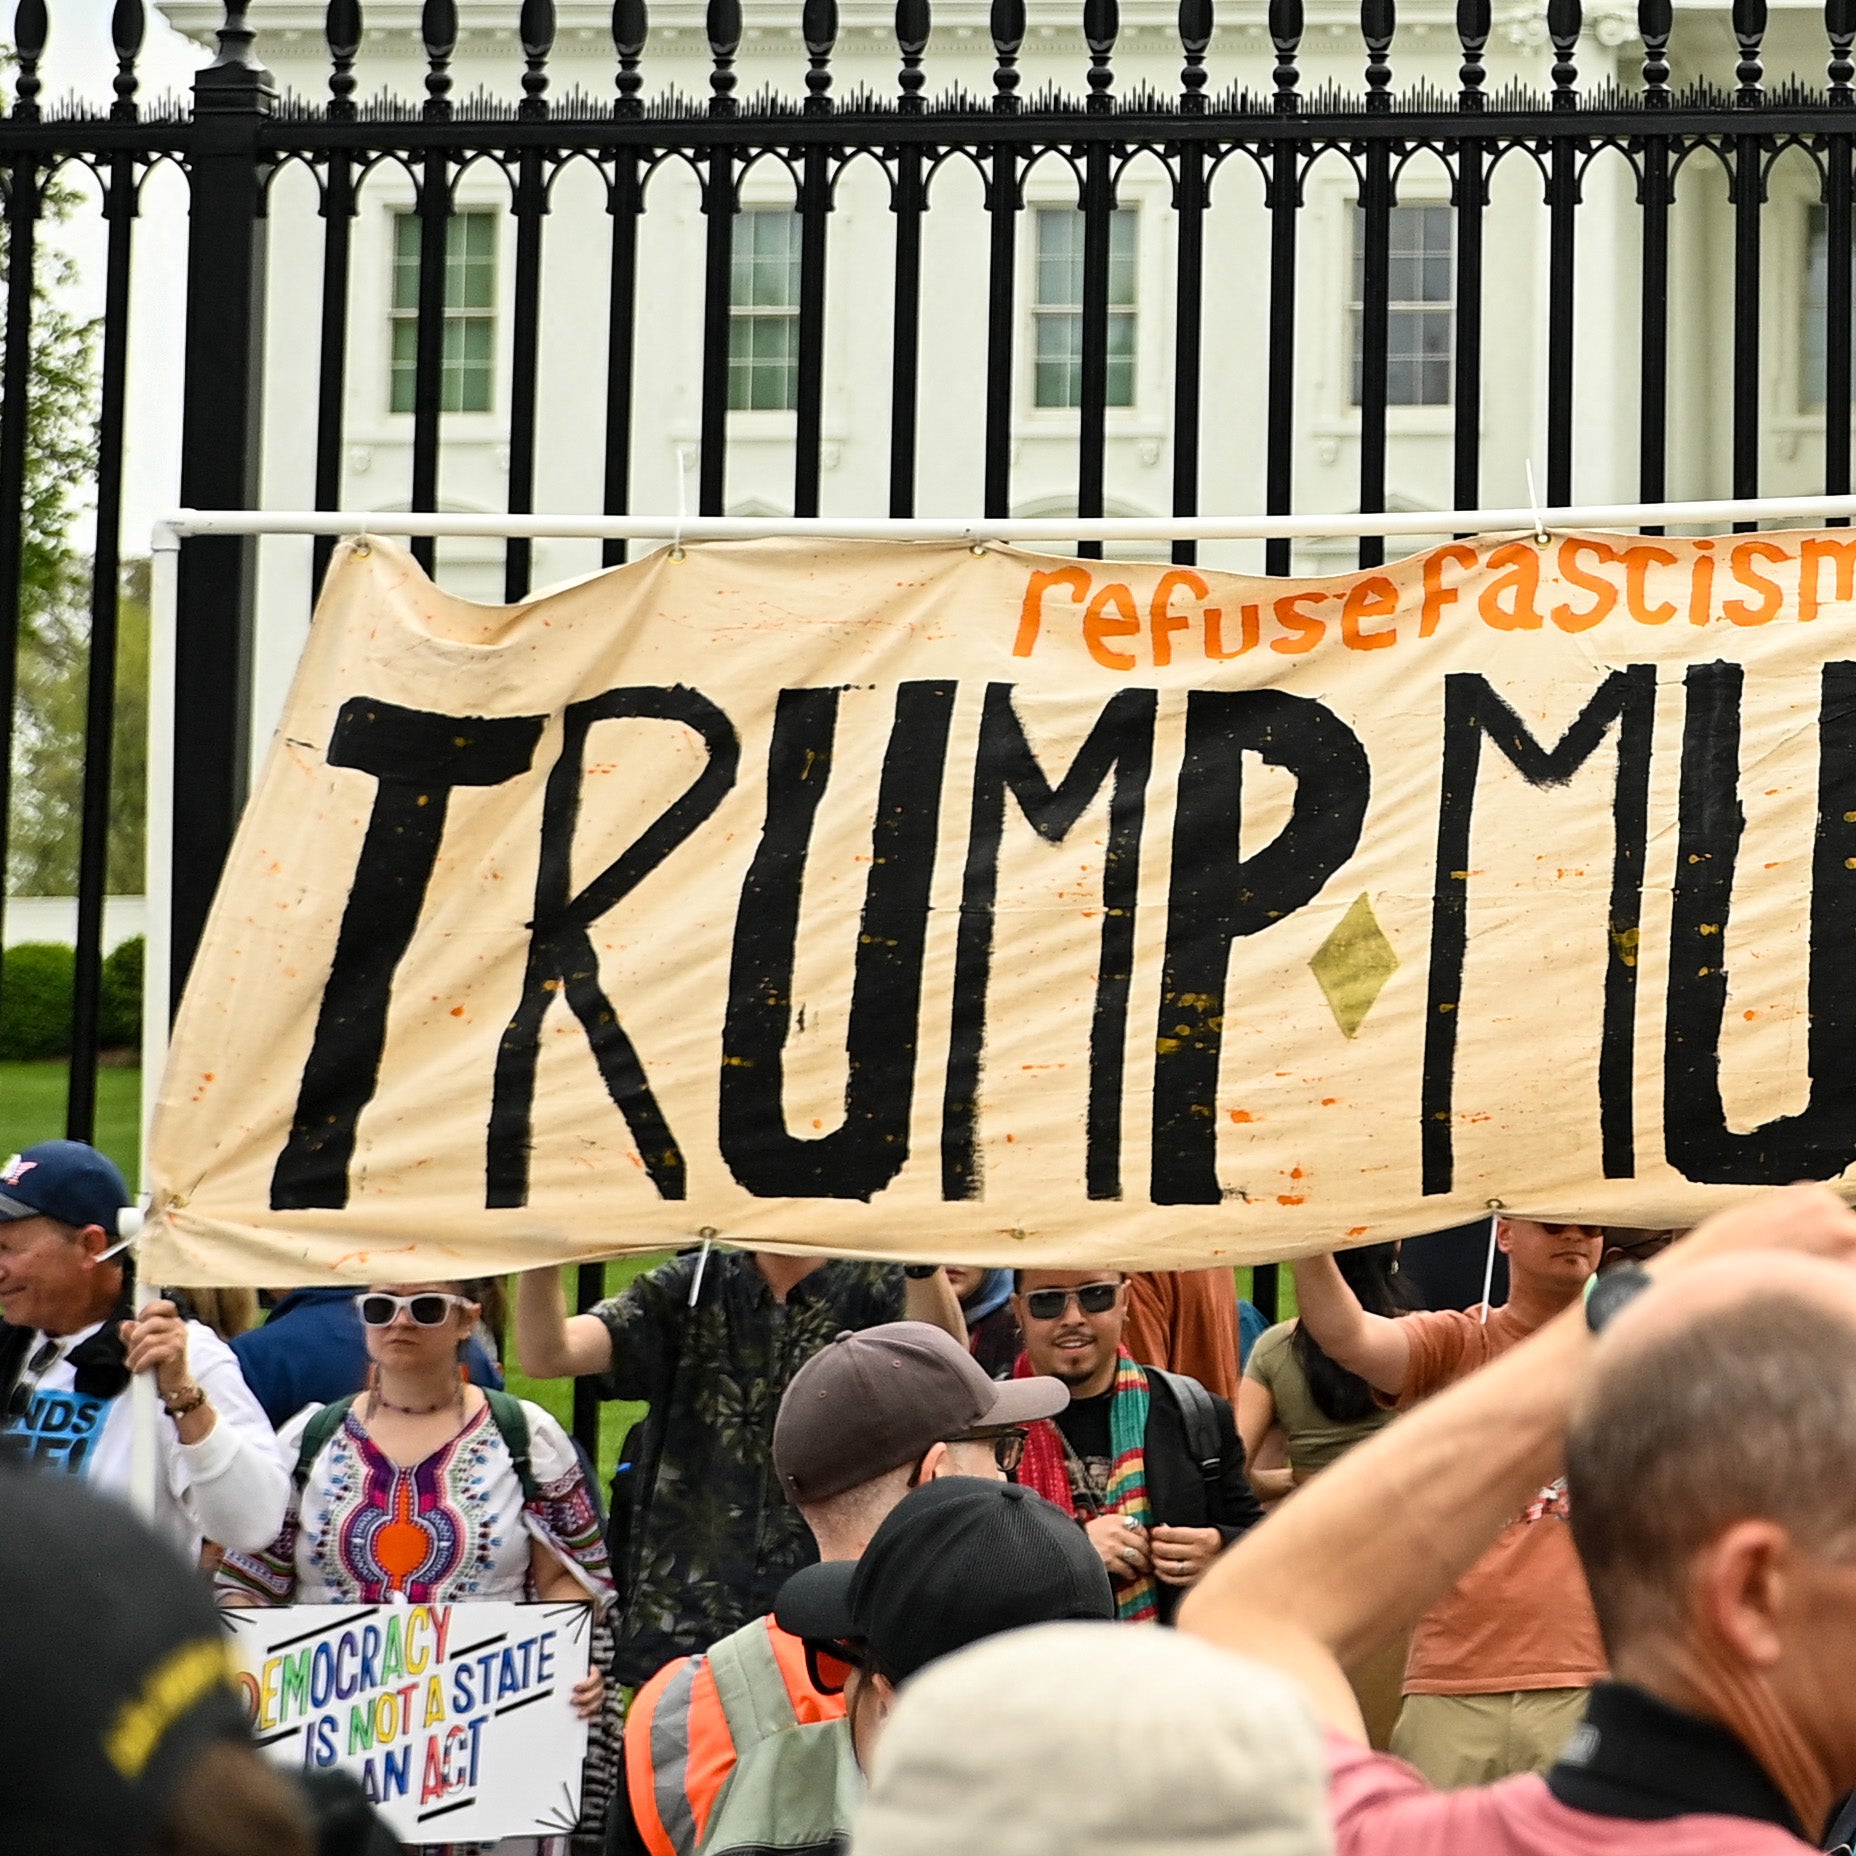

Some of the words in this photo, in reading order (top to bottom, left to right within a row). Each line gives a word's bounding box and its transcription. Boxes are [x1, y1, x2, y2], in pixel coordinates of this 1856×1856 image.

[269, 678, 1372, 1211] TRUMP
[304, 1714, 340, 1771] IS
[348, 1682, 420, 1756] NOT
[423, 1674, 447, 1729] A
[451, 1630, 558, 1715] STATE
[362, 1744, 413, 1805] AN
[420, 1714, 491, 1806] ACT
